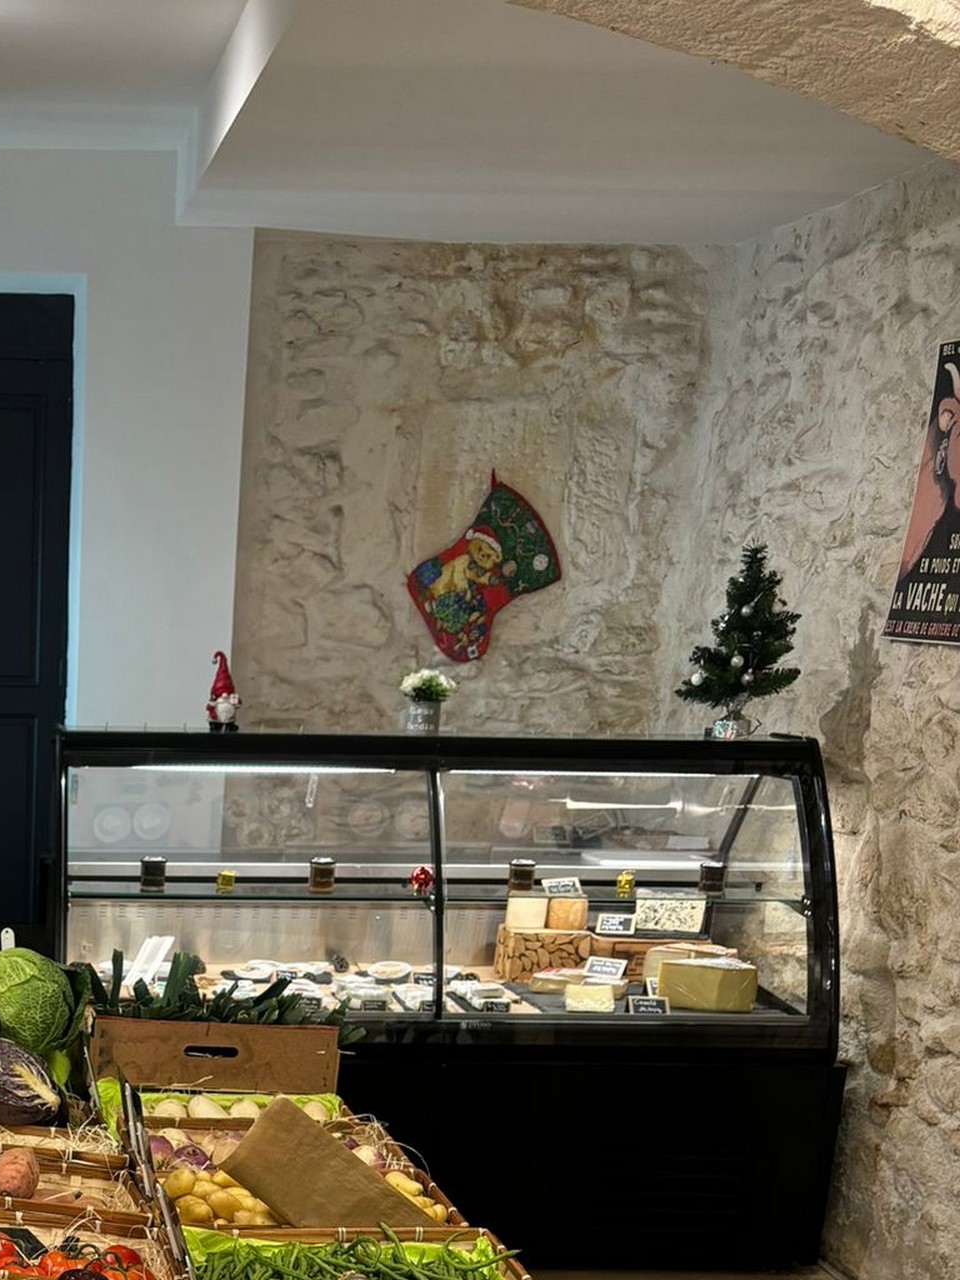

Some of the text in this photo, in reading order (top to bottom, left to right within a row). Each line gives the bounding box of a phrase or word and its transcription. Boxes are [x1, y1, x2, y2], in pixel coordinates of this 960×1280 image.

[919, 557, 930, 573] EN
[892, 591, 903, 609] LA
[906, 582, 947, 611] VACHE
